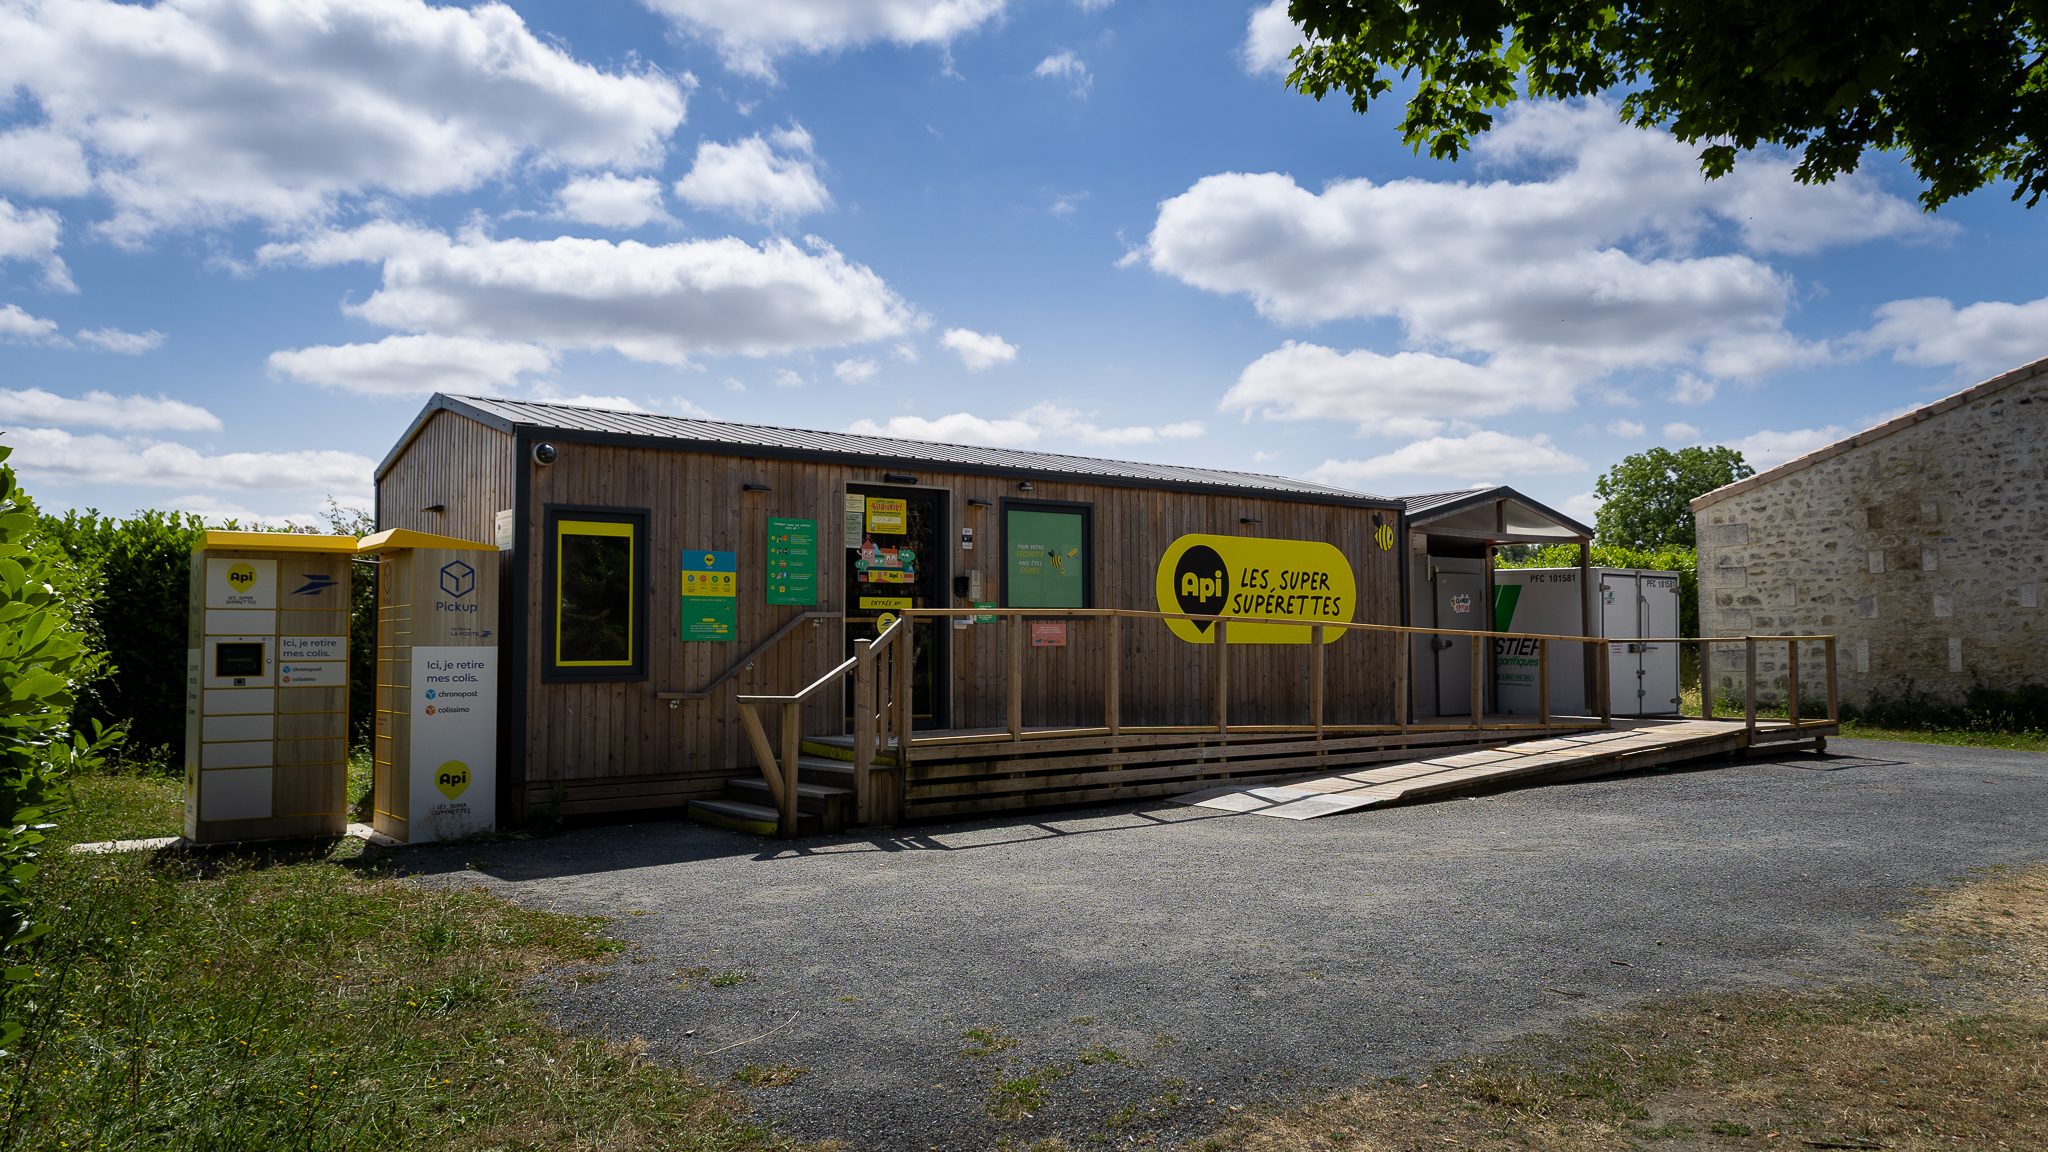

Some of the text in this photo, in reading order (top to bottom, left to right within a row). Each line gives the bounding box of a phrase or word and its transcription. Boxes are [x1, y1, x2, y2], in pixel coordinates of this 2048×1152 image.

[1019, 565, 1040, 574] FILMÉS
[230, 571, 253, 583] Api
[1241, 568, 1330, 591] LES SUPER
[1530, 574, 1576, 583] PFC 101581
[1181, 570, 1222, 603] Api
[1647, 579, 1675, 588] PFC 101581
[1232, 587, 1341, 616] SUPÉRETTES
[436, 601, 478, 614] Pickup
[283, 639, 337, 648] Ici, je retire
[306, 649, 330, 657] colis.
[427, 660, 485, 671] Ici, je retire
[452, 673, 478, 682] colis.
[438, 690, 478, 698] chronopost
[439, 771, 466, 787] Api
